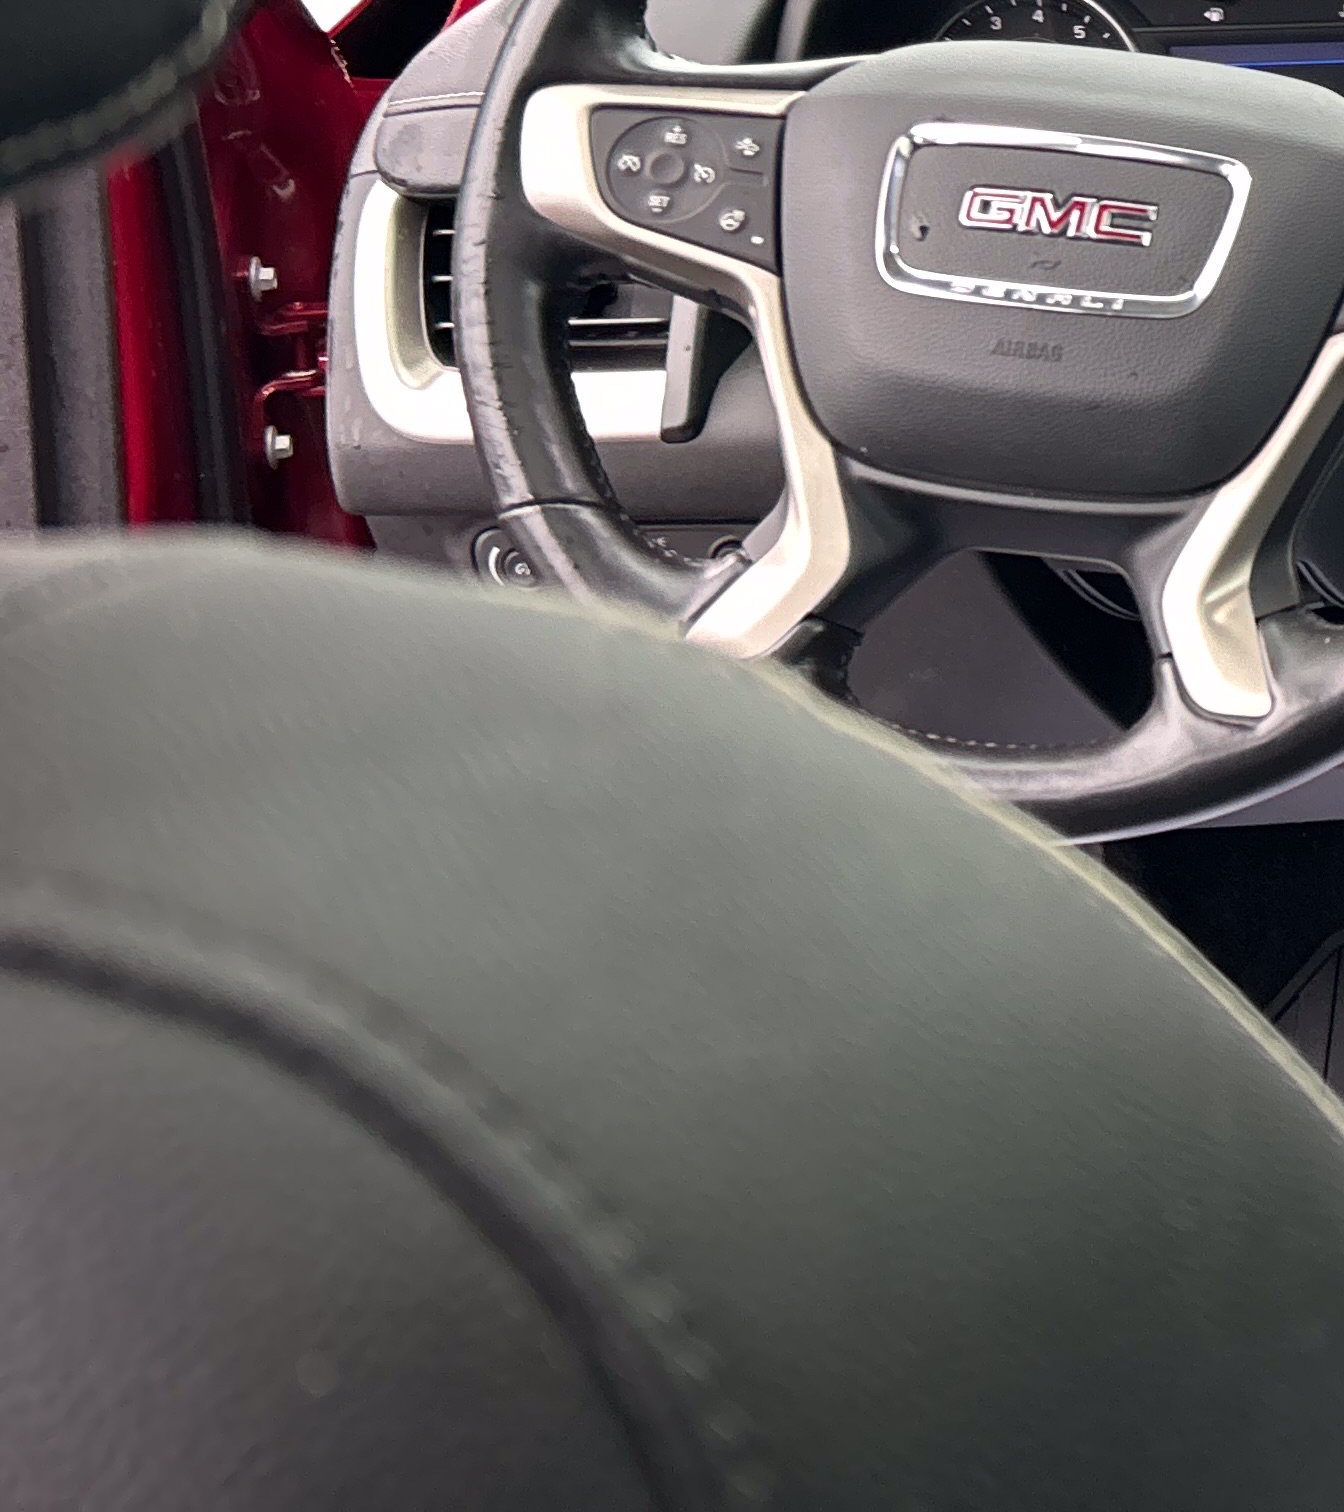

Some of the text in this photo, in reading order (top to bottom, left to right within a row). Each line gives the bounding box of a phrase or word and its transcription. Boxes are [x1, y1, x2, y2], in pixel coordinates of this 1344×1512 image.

[990, 15, 1002, 31] 3
[1031, 9, 1044, 24] 4
[1072, 25, 1086, 39] 5
[958, 184, 1159, 247] GMC
